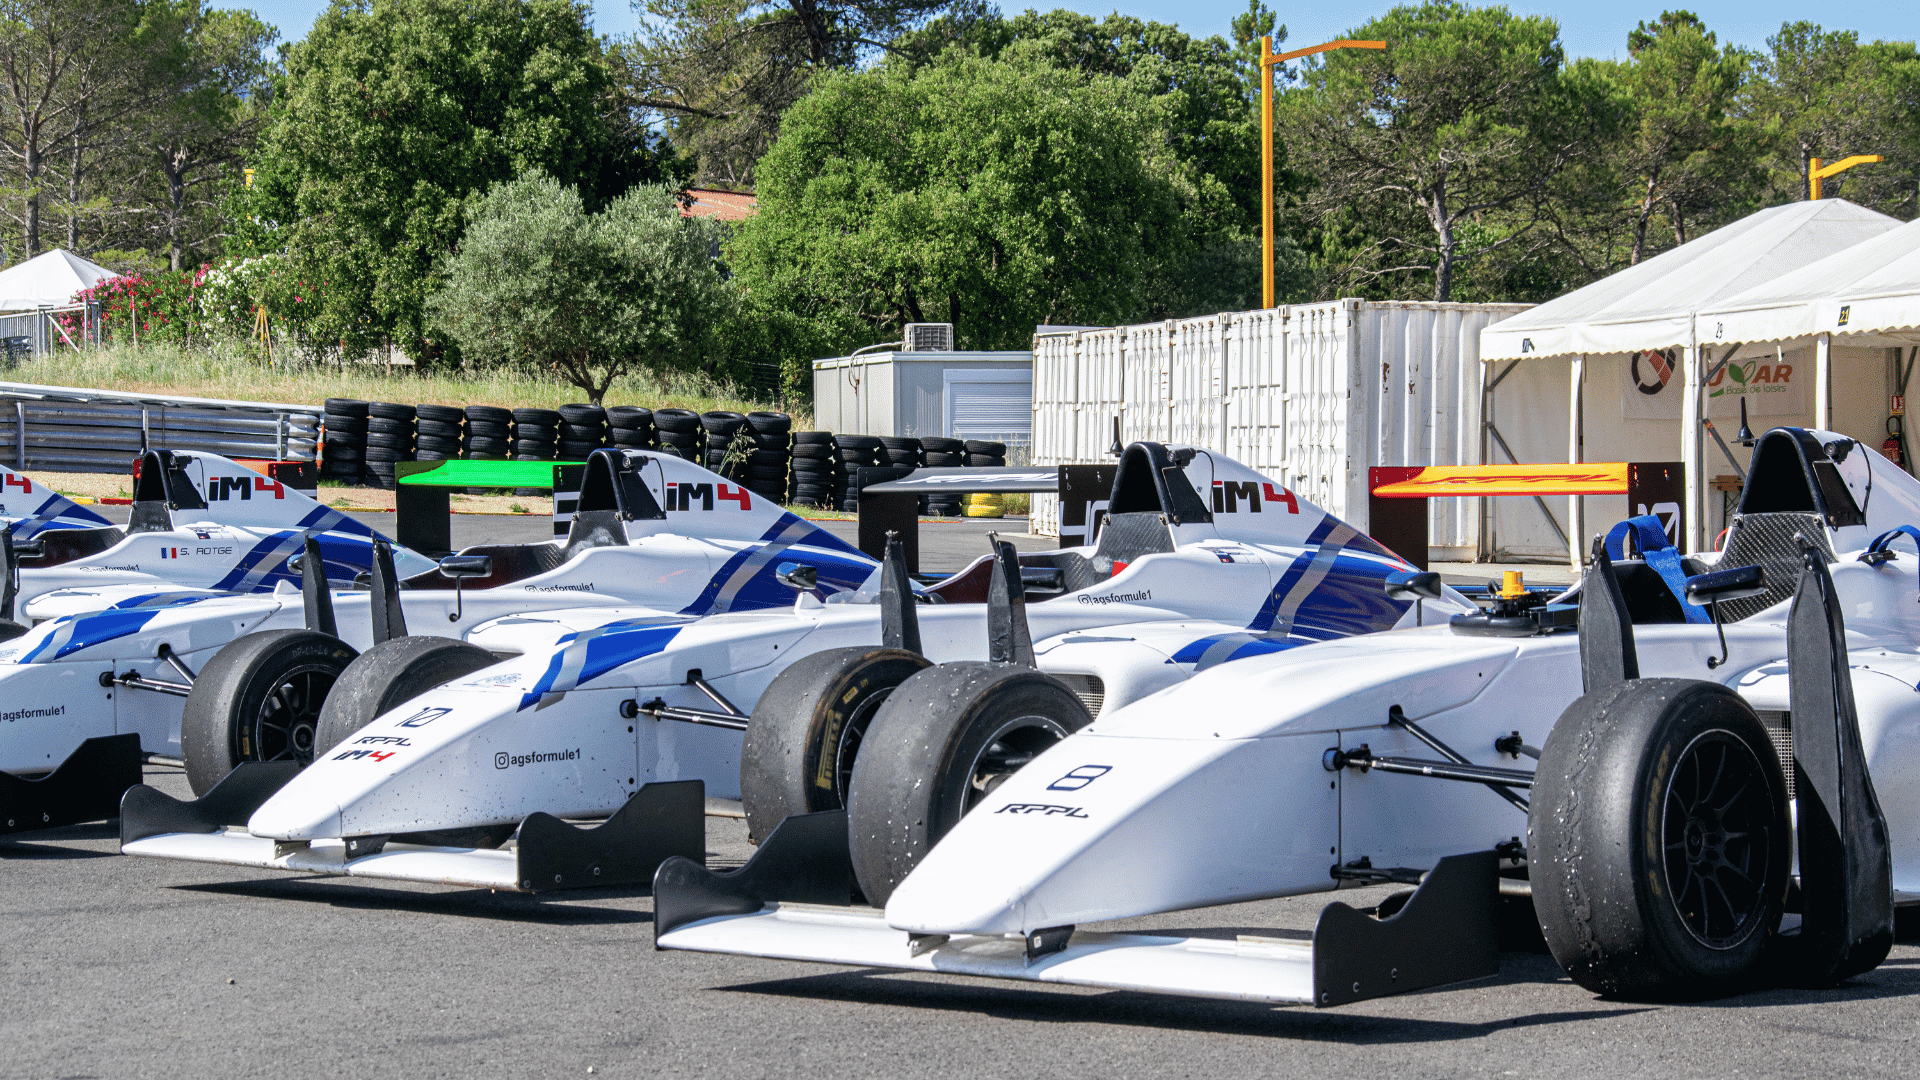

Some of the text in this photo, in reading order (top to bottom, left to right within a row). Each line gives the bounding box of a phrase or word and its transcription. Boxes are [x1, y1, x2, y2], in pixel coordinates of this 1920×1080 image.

[1726, 384, 1787, 394] Base de loisirs
[180, 548, 190, 556] S.
[1093, 589, 1152, 605] agsformule1
[3, 705, 65, 722] agsformule1
[511, 747, 580, 768] agsformule1
[1046, 764, 1113, 792] 8
